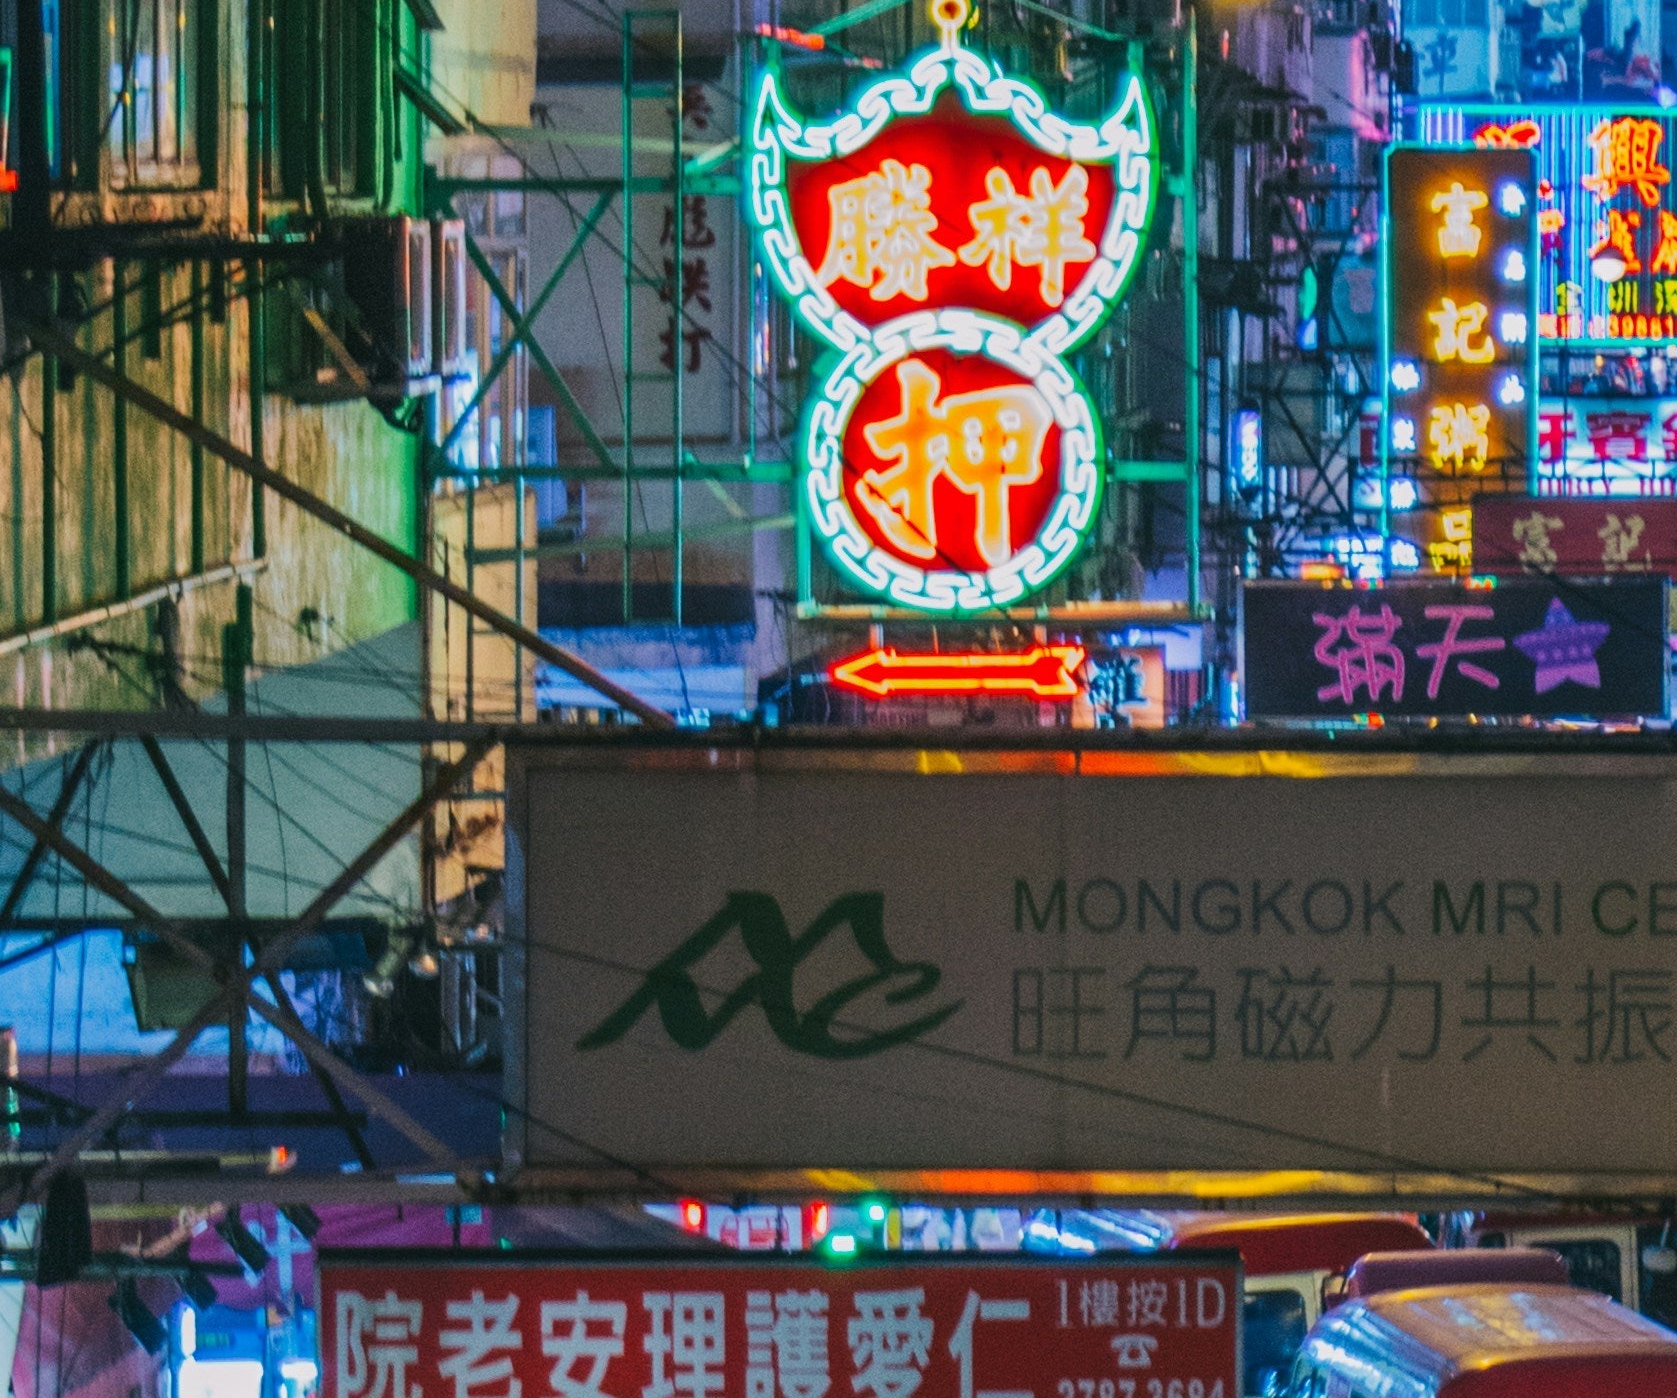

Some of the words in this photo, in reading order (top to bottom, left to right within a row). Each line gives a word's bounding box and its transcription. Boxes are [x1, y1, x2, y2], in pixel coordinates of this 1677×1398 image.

[856, 359, 1054, 571] 押
[1012, 878, 1404, 939] MONGKOK
[1430, 880, 1562, 939] MRI
